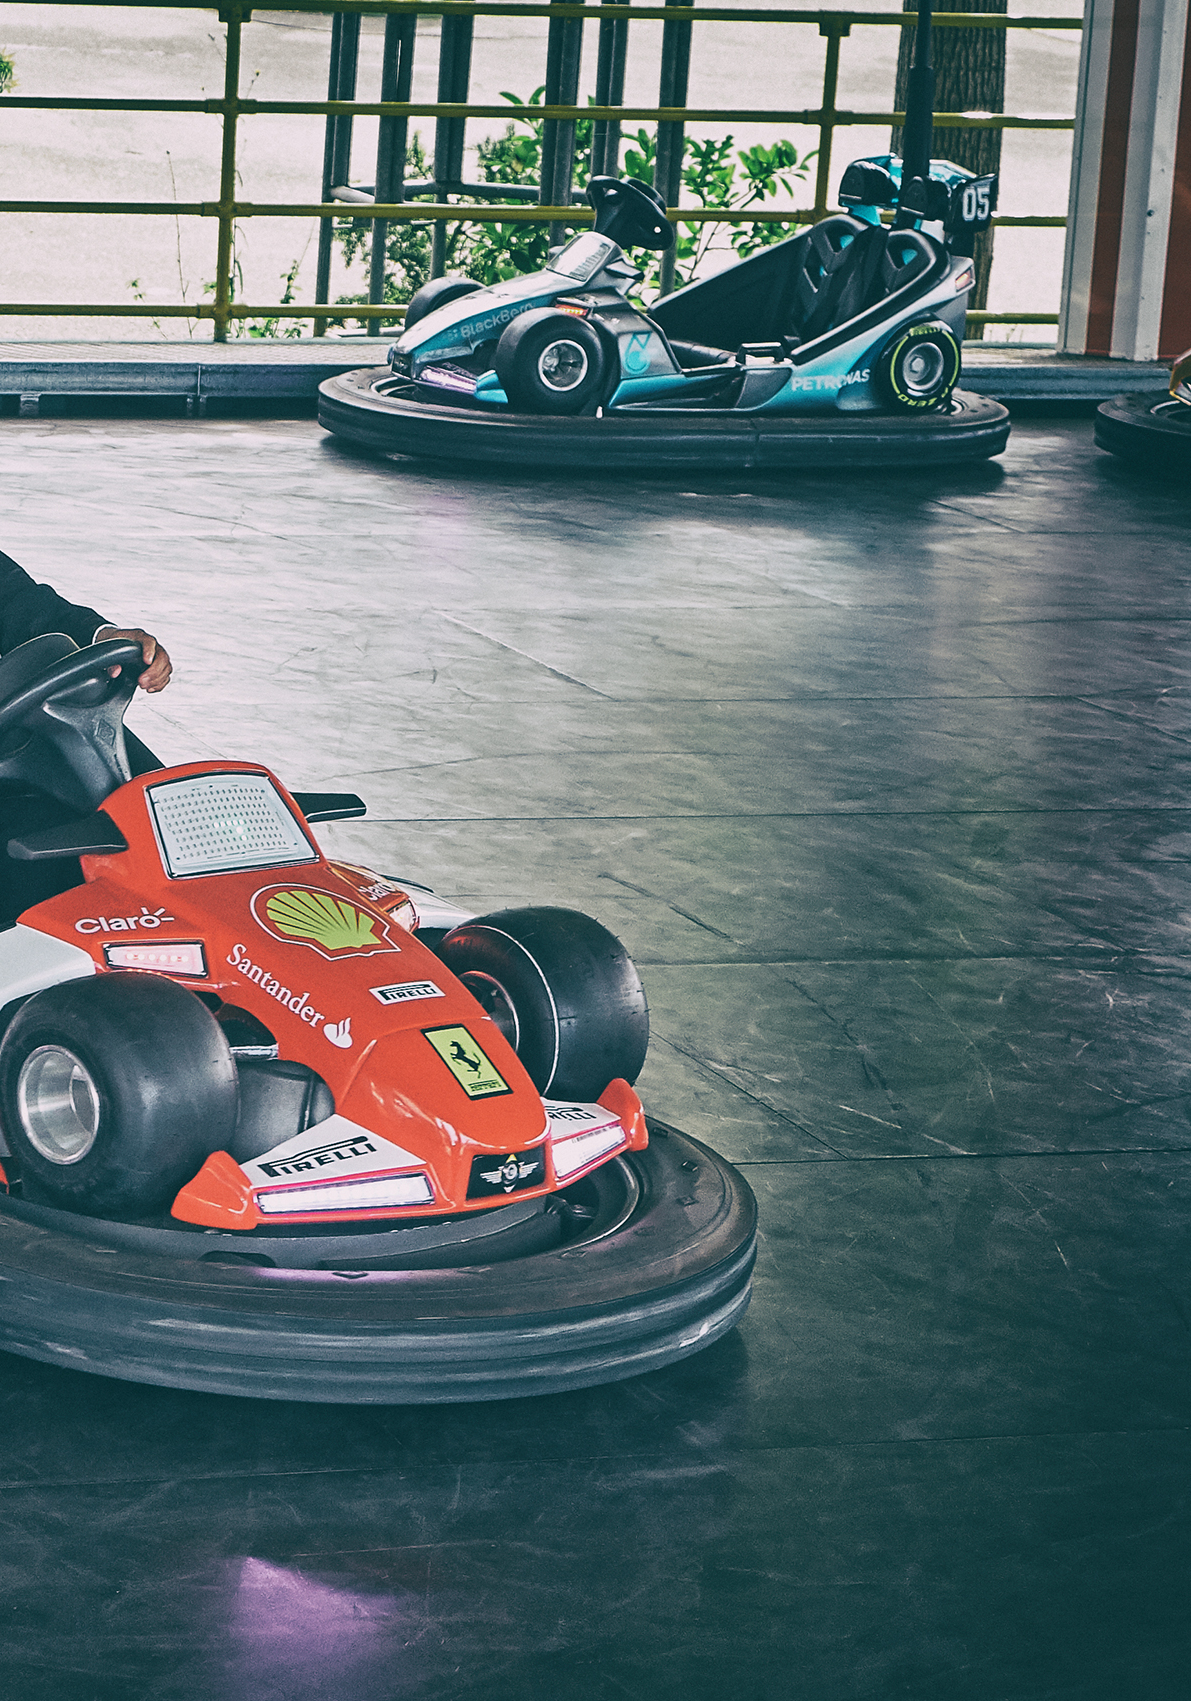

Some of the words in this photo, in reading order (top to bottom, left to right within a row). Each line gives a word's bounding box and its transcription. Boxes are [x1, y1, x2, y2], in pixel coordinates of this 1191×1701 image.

[962, 185, 991, 222] 05
[791, 368, 871, 392] PETRONAS
[226, 943, 326, 1028] Santander
[377, 983, 438, 1001] PIRELLI
[257, 1135, 378, 1178] PIRELLI
